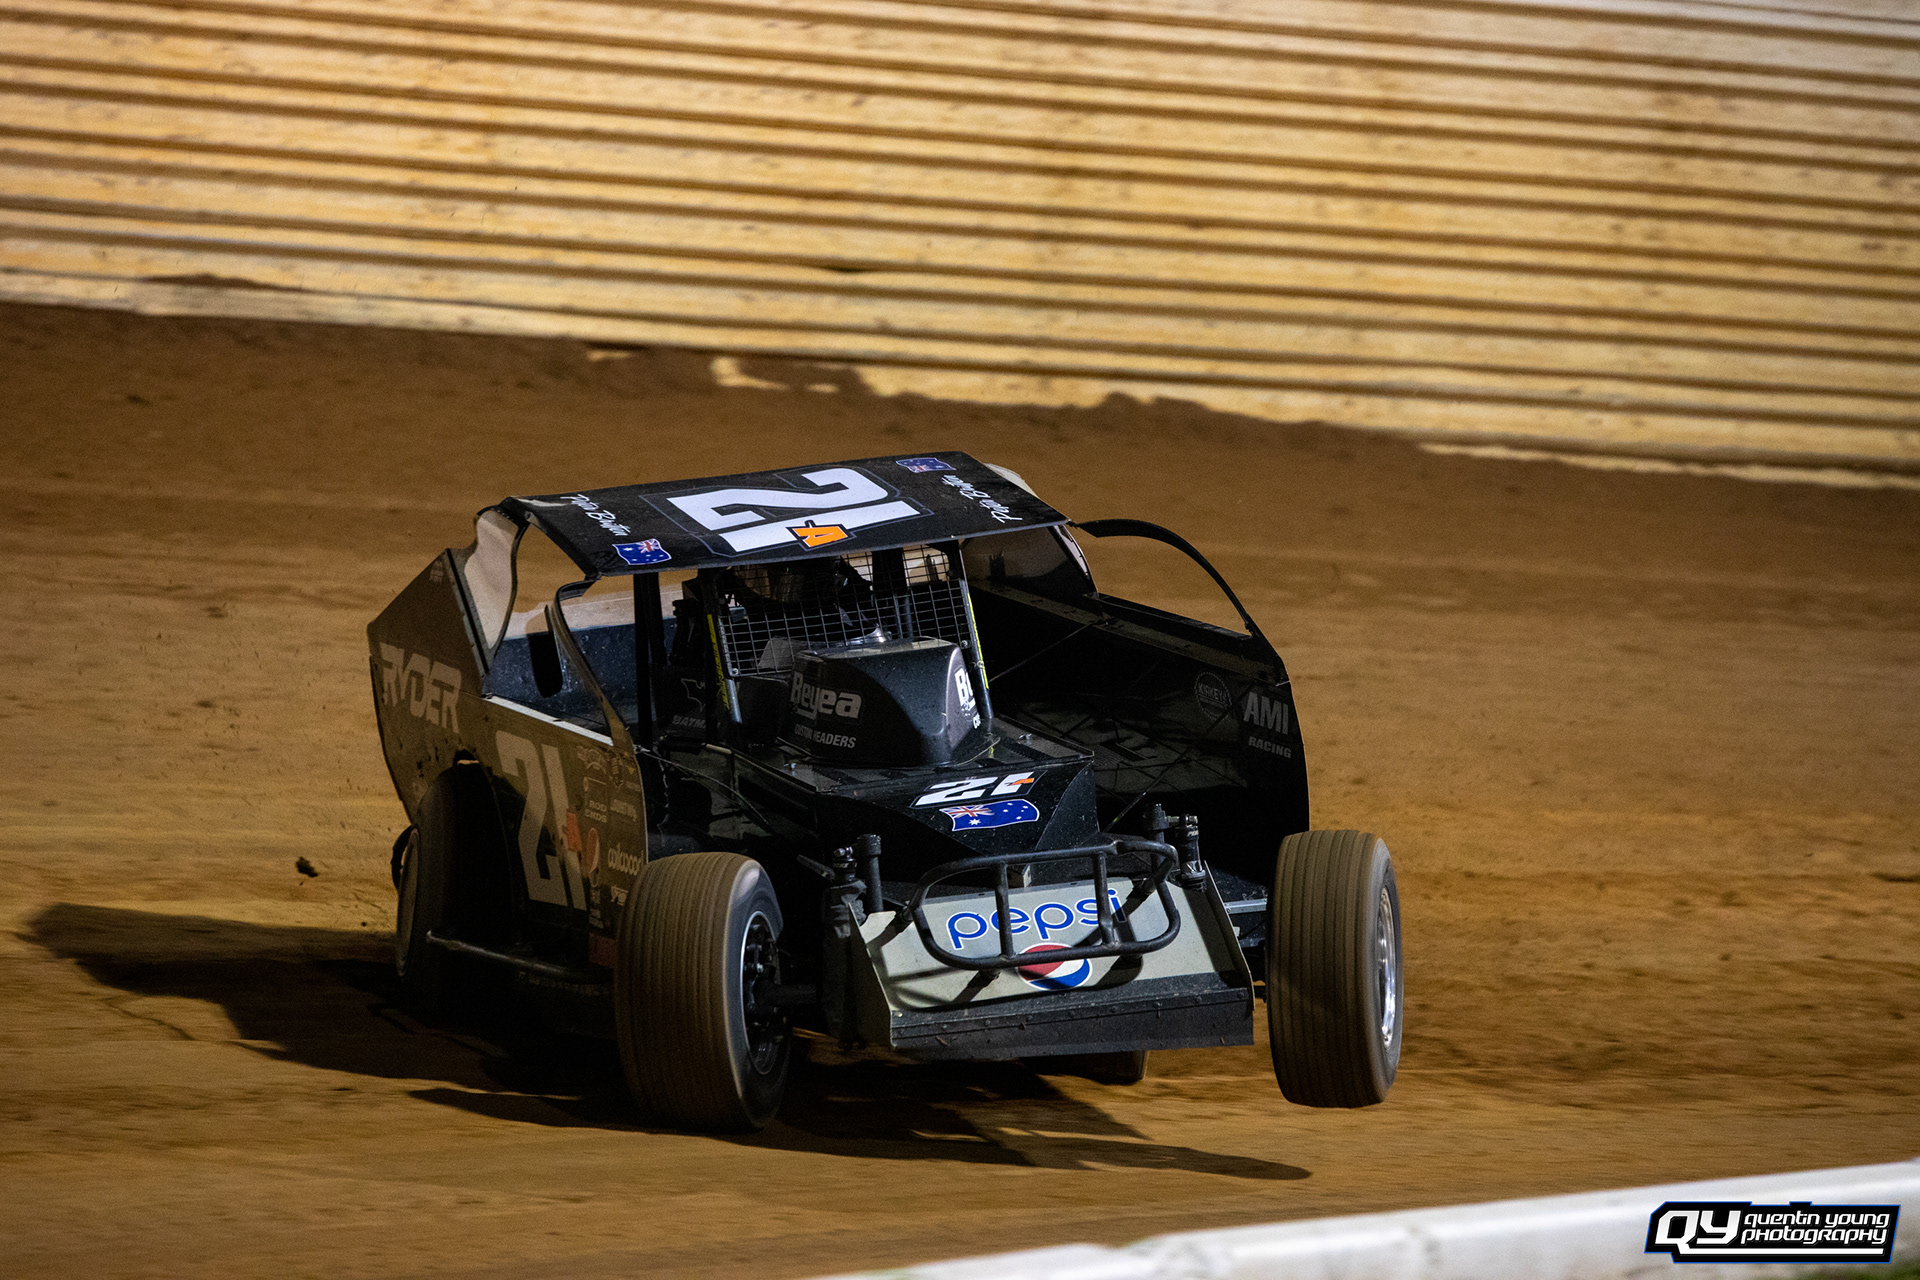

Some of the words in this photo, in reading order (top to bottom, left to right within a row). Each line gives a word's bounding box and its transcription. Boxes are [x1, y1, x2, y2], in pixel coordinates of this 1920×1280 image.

[379, 641, 462, 734] RYDER
[790, 671, 862, 720] Beyea
[1243, 691, 1289, 735] AMI
[1248, 736, 1292, 759] RACING
[588, 799, 608, 813] ROD
[948, 889, 1126, 949] pepsi
